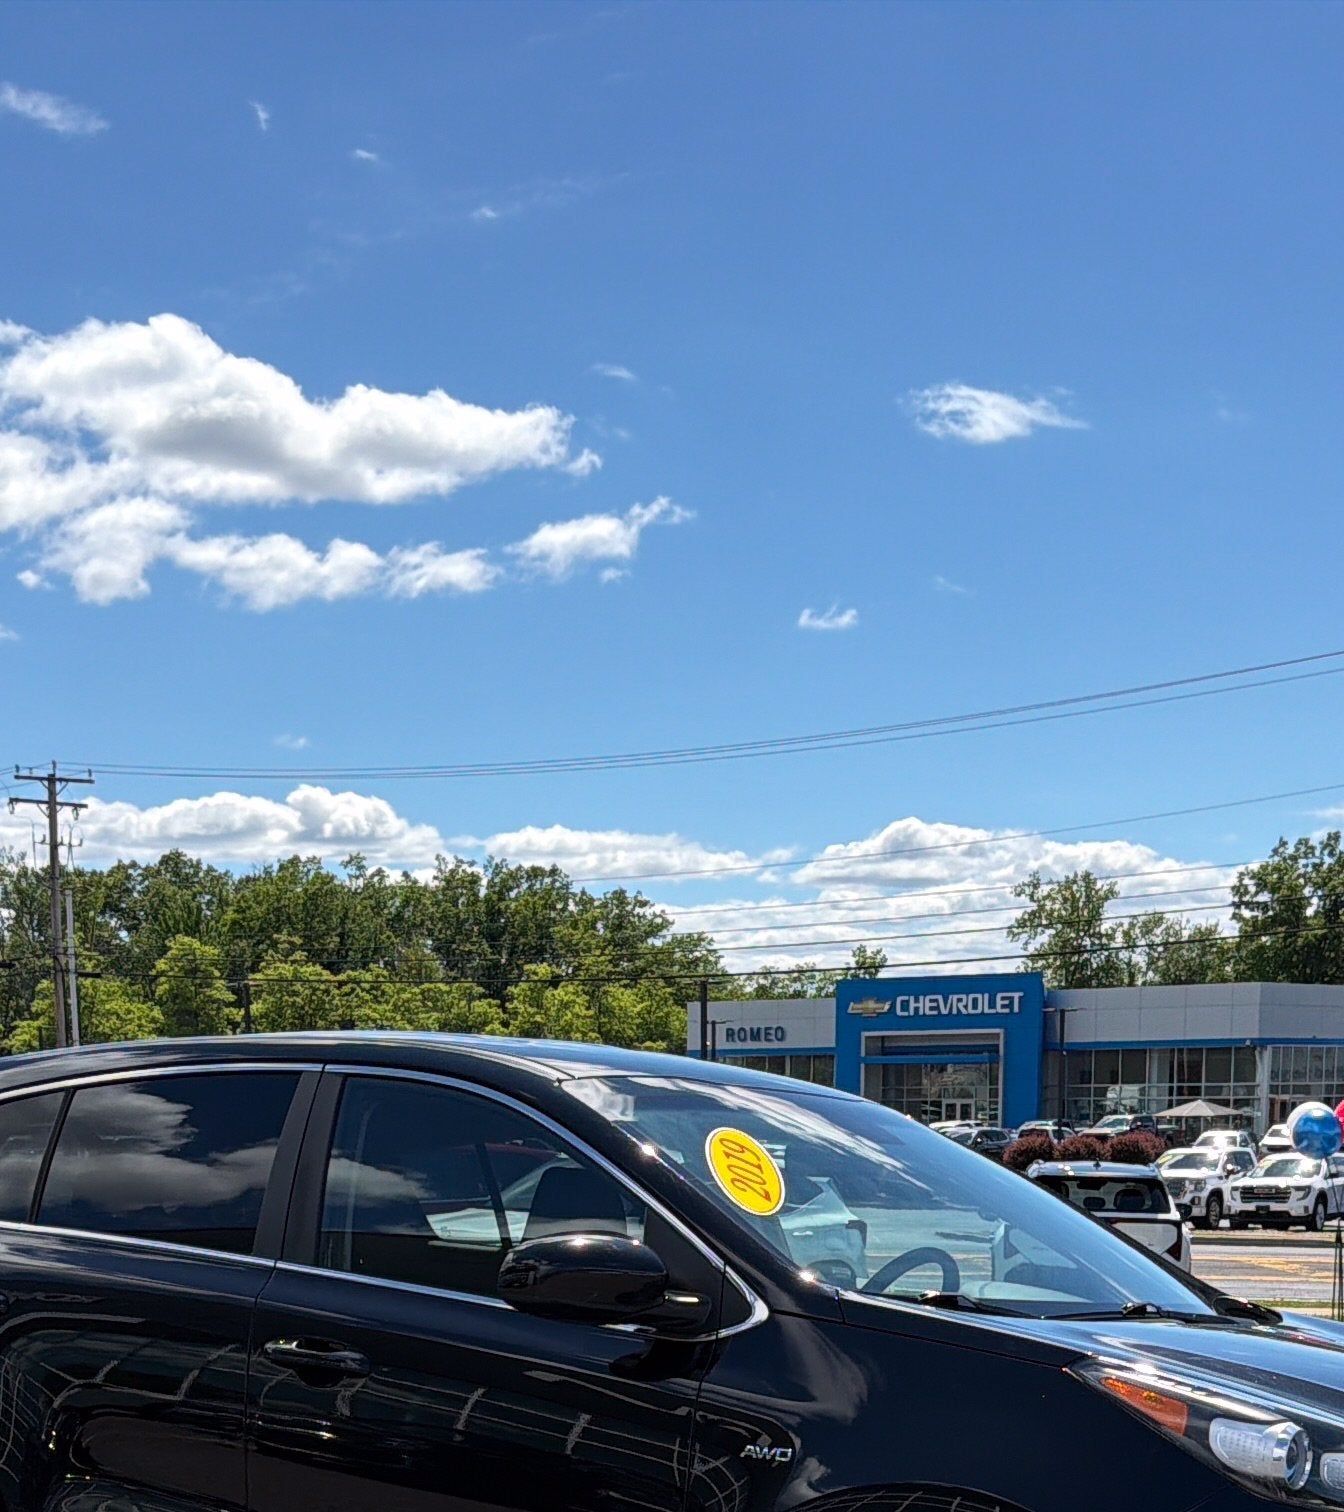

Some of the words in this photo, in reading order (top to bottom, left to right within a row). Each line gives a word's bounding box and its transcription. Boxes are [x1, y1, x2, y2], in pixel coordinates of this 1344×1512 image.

[896, 992, 1024, 1017] CHEVROLET
[725, 1026, 786, 1043] ROMEO
[718, 1137, 771, 1203] 2019
[739, 1444, 793, 1462] AWD
